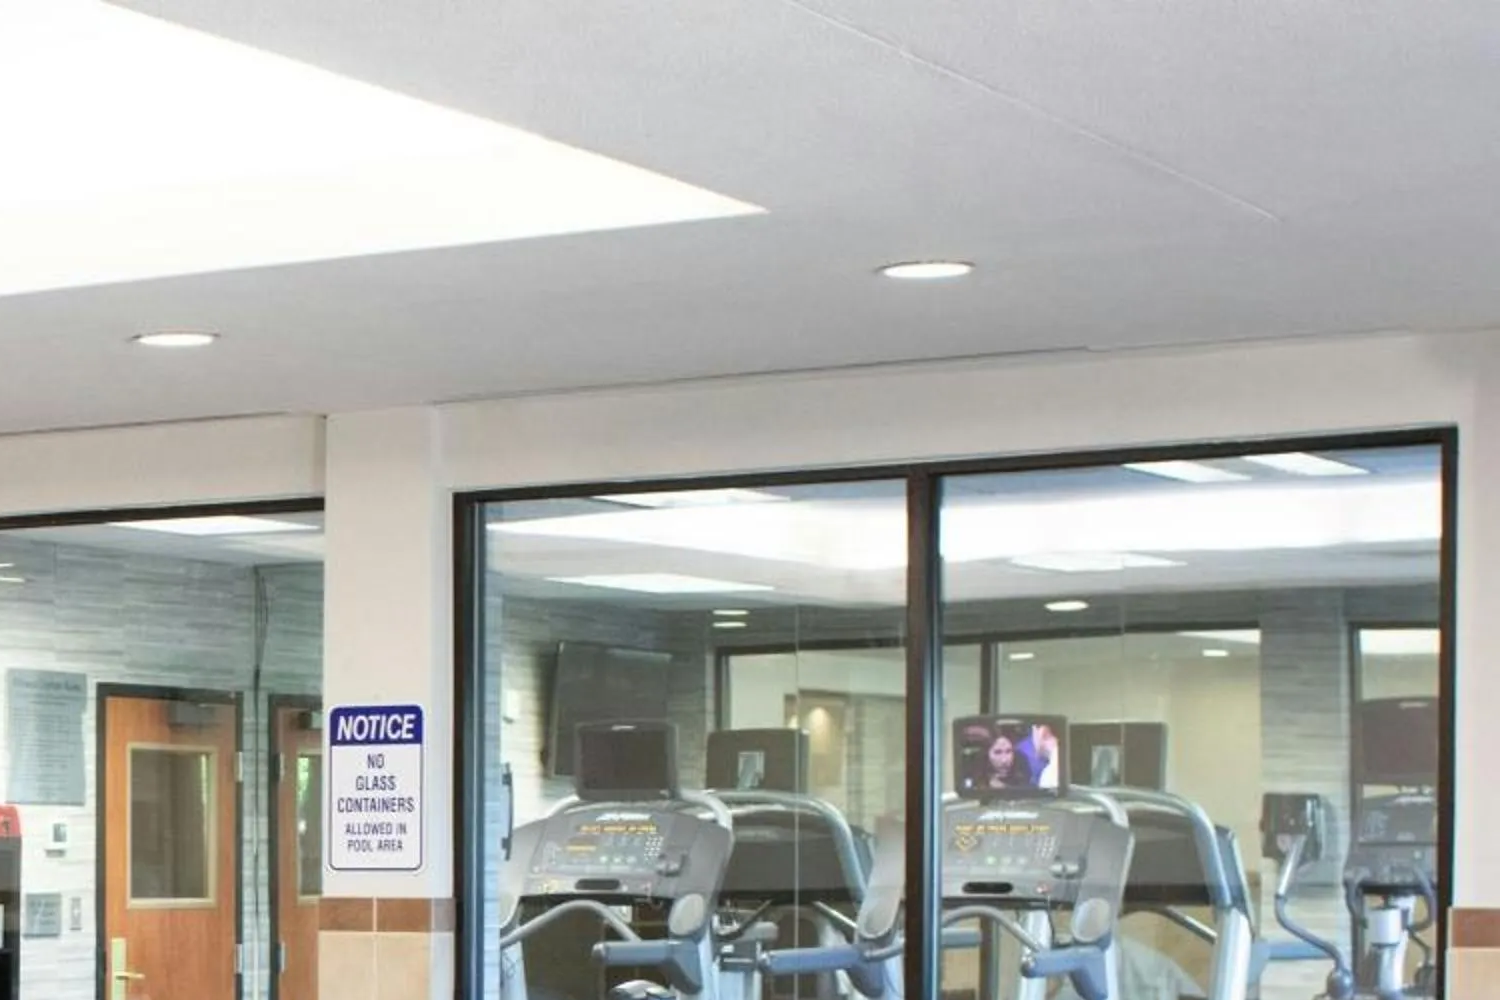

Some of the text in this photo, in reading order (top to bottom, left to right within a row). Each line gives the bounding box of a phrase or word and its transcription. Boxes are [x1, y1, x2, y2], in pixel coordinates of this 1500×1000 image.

[336, 713, 417, 741] NOTICE
[367, 753, 385, 769] NO
[355, 775, 397, 791] GLASS
[337, 796, 415, 813] CONTAINERS
[345, 822, 408, 836] ALLOWED IN
[347, 839, 403, 853] POOL AREA
